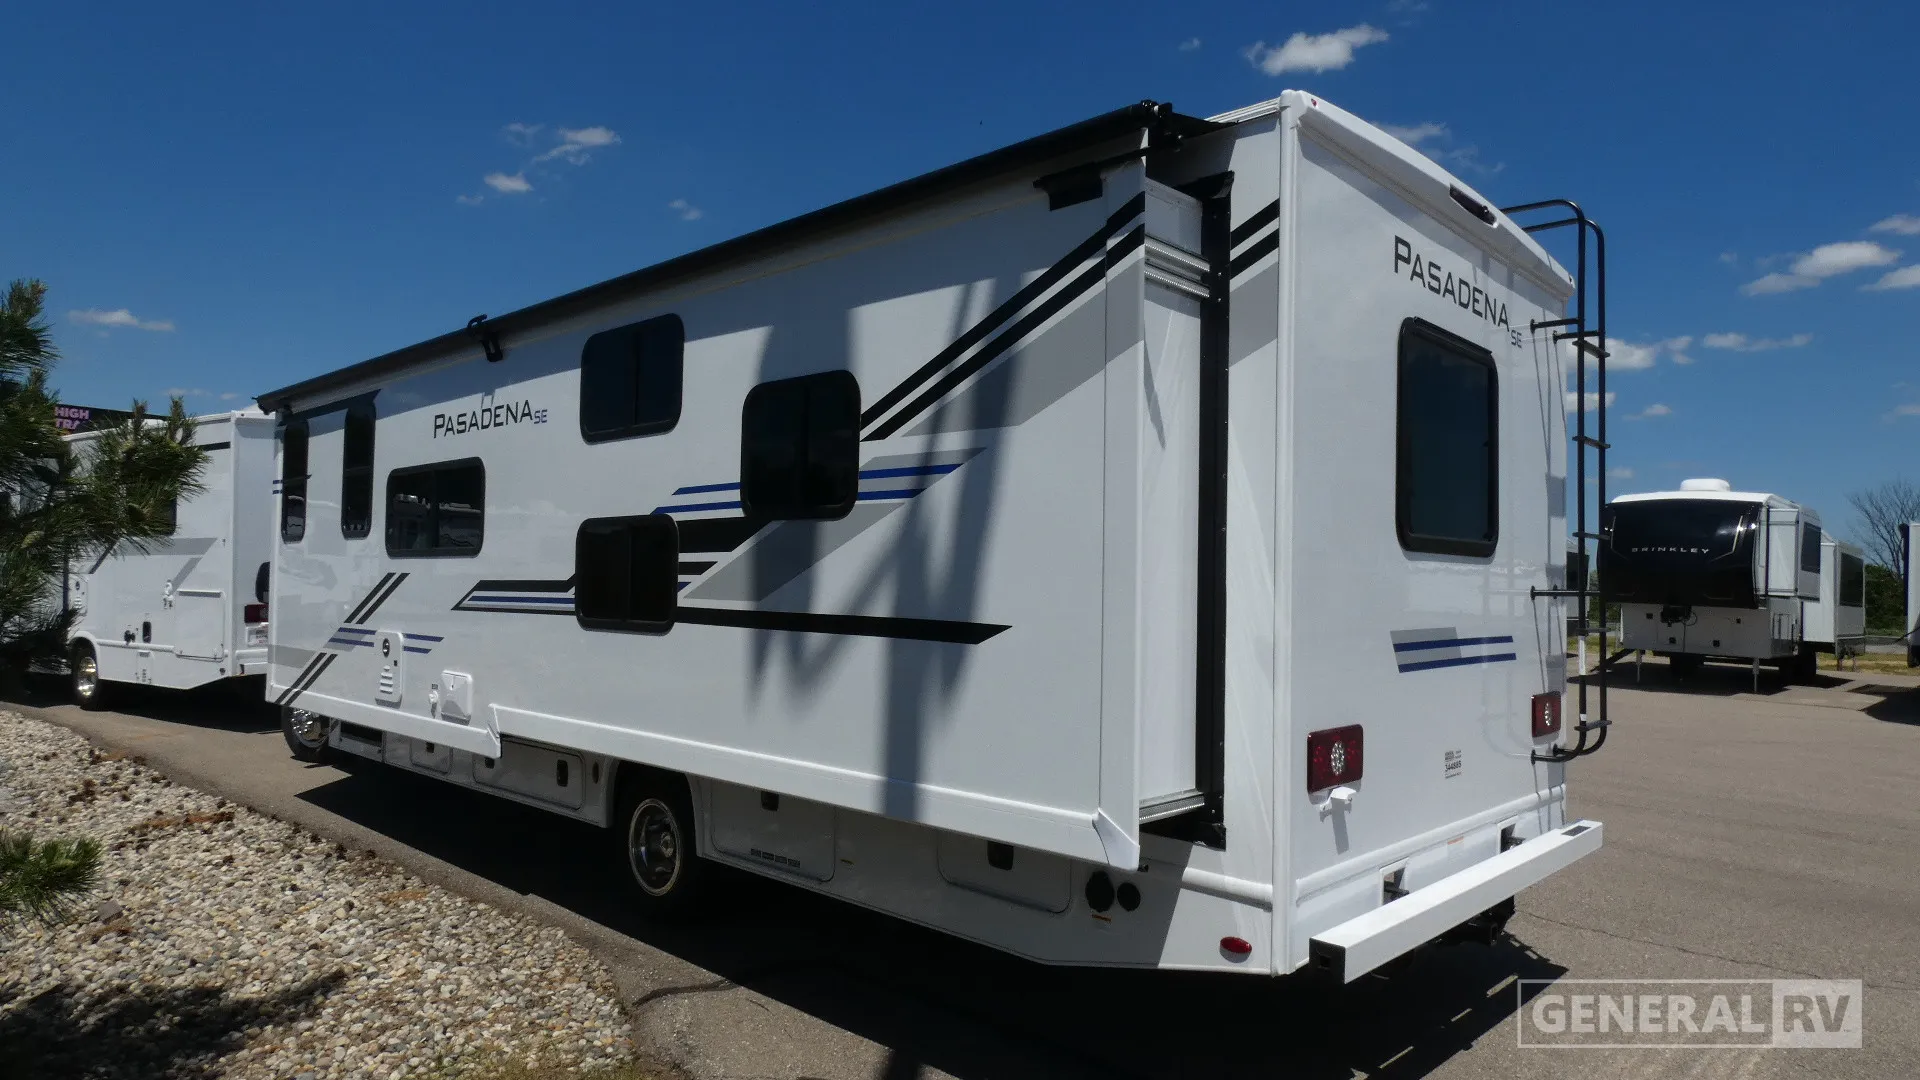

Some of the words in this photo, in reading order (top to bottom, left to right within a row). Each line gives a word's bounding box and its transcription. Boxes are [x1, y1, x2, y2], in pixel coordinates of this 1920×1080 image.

[1394, 235, 1510, 332] PASADENA
[1510, 329, 1522, 349] SE
[54, 407, 89, 420] HIGH
[433, 400, 533, 439] PASADENA
[533, 409, 548, 425] SE
